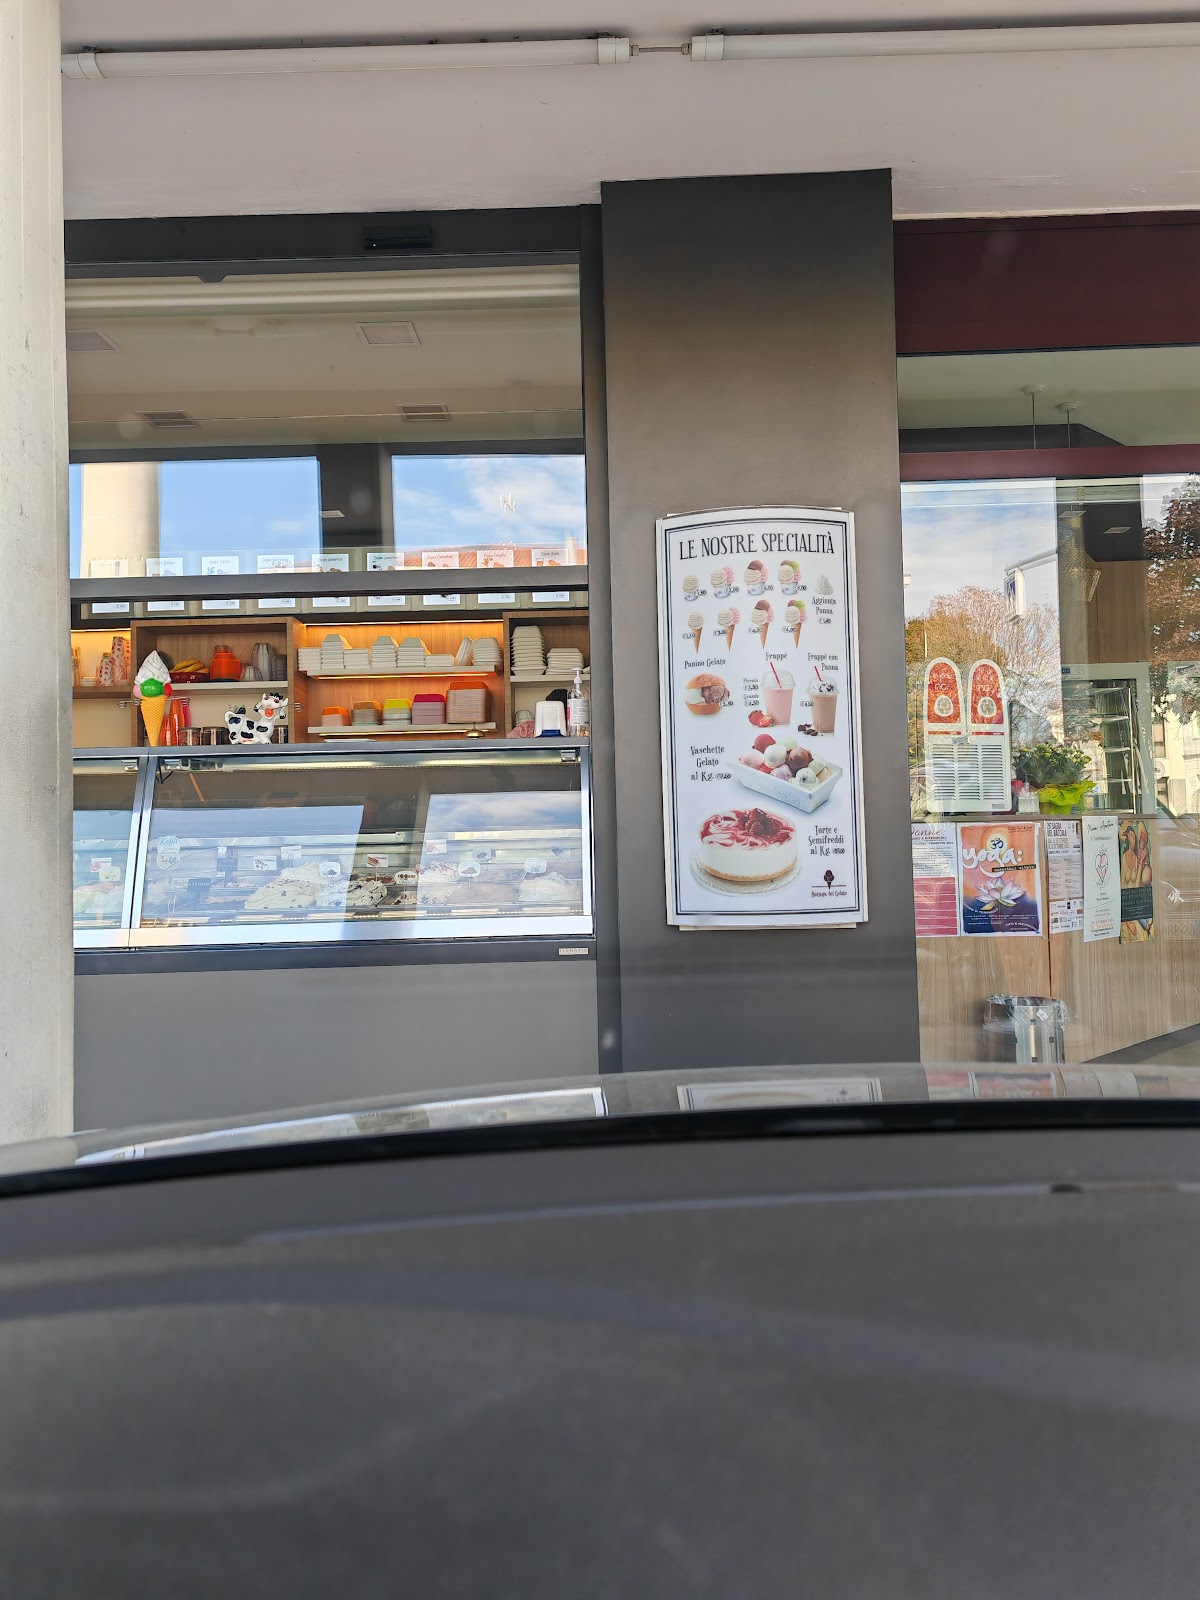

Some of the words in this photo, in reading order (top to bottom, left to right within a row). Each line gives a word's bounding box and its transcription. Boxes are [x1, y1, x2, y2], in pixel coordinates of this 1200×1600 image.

[679, 540, 697, 560] LE
[701, 534, 757, 557] NOSTRE
[760, 531, 834, 554] SPECIALITÀ
[812, 596, 837, 606] Aggiunta
[815, 607, 833, 615] Panna
[766, 652, 788, 661] Frappé
[808, 653, 827, 662] Frappé
[684, 660, 704, 669] Panino
[706, 658, 726, 668] Gelato
[822, 663, 838, 671] Panna
[690, 745, 725, 756] Vaschette
[696, 757, 720, 768] Gelato
[690, 772, 699, 781] al
[814, 825, 831, 836] Torte
[808, 835, 844, 846] Semifreddi
[810, 846, 818, 855] al
